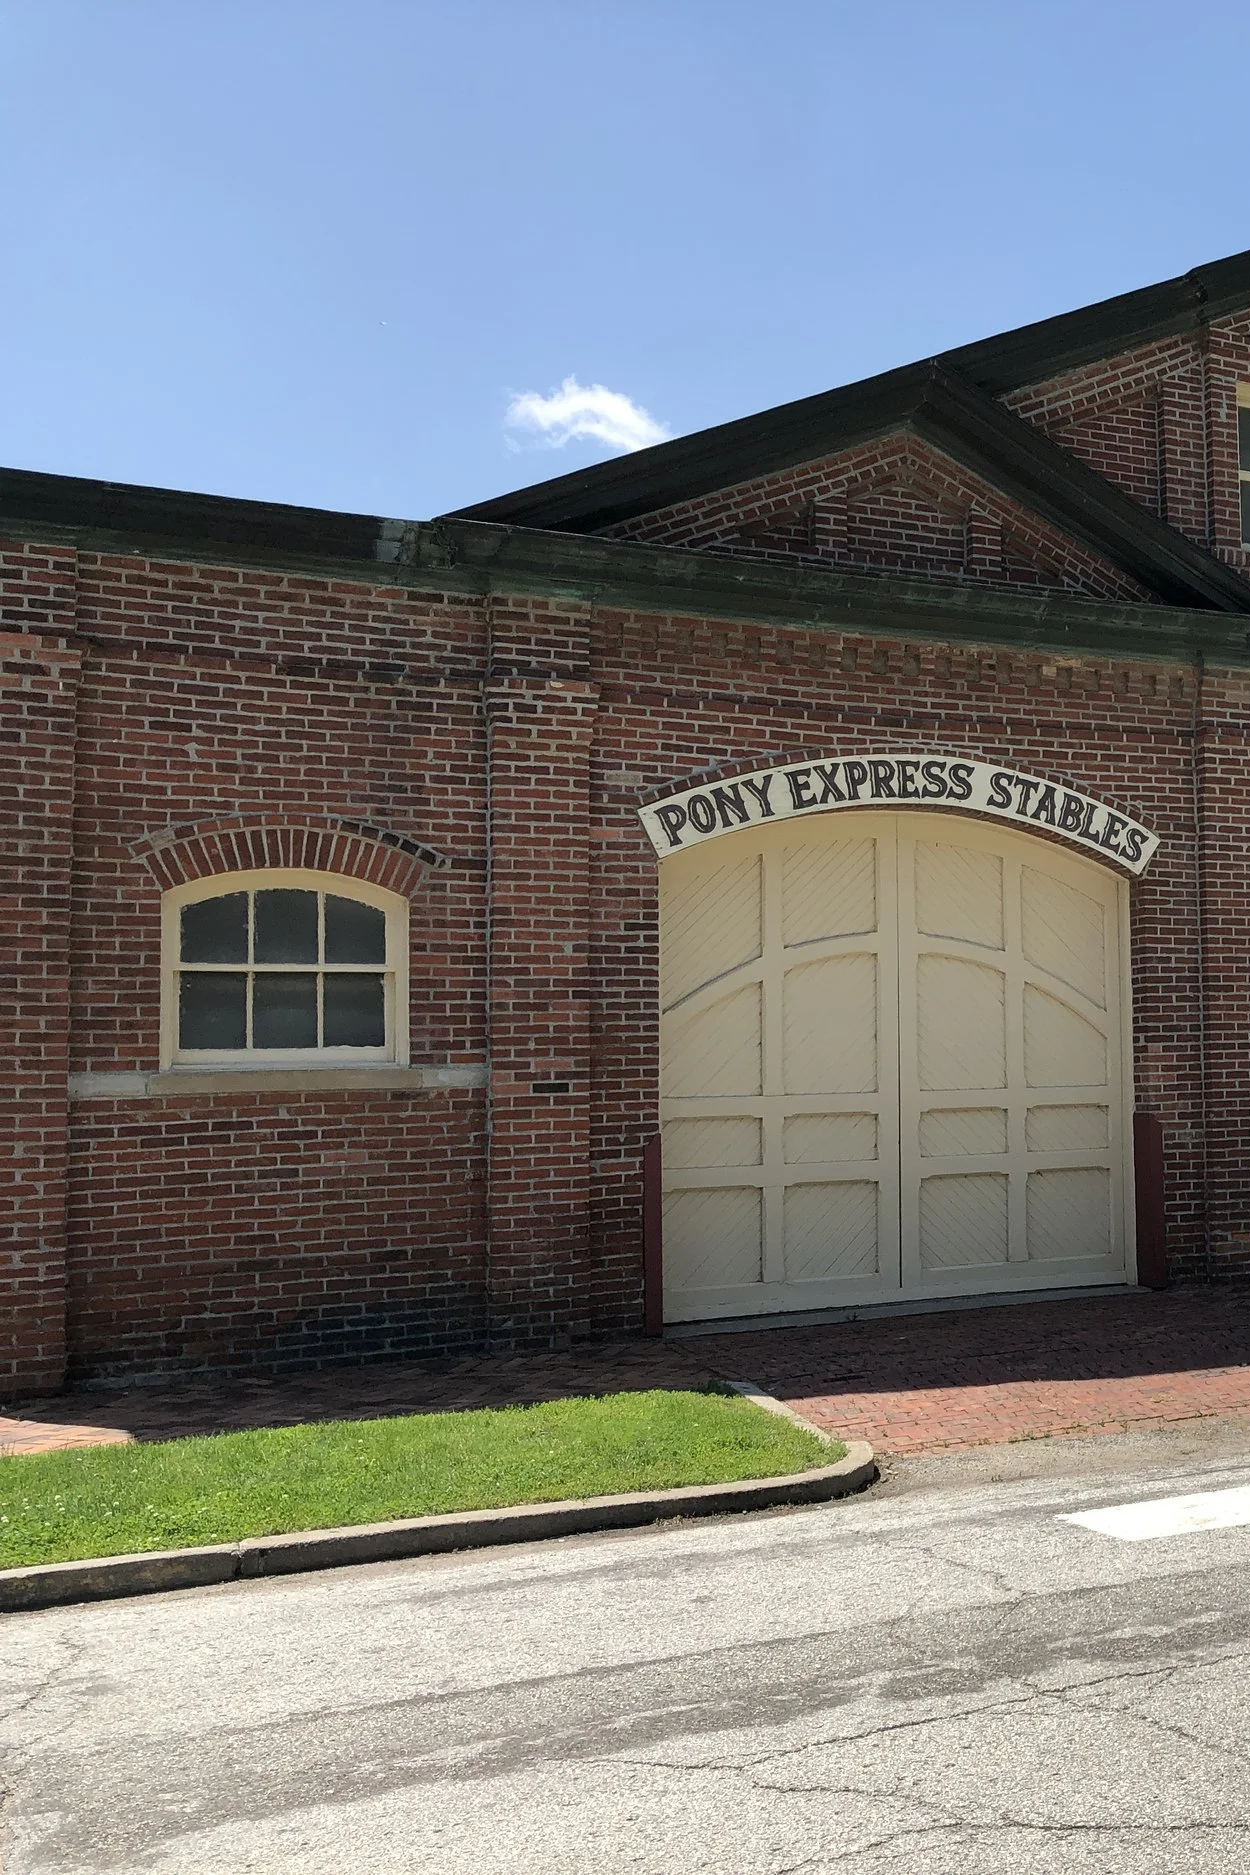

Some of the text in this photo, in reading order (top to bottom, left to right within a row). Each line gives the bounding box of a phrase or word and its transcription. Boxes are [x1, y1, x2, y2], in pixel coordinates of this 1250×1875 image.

[653, 760, 1149, 862] PONY EXPRESS STABLES
